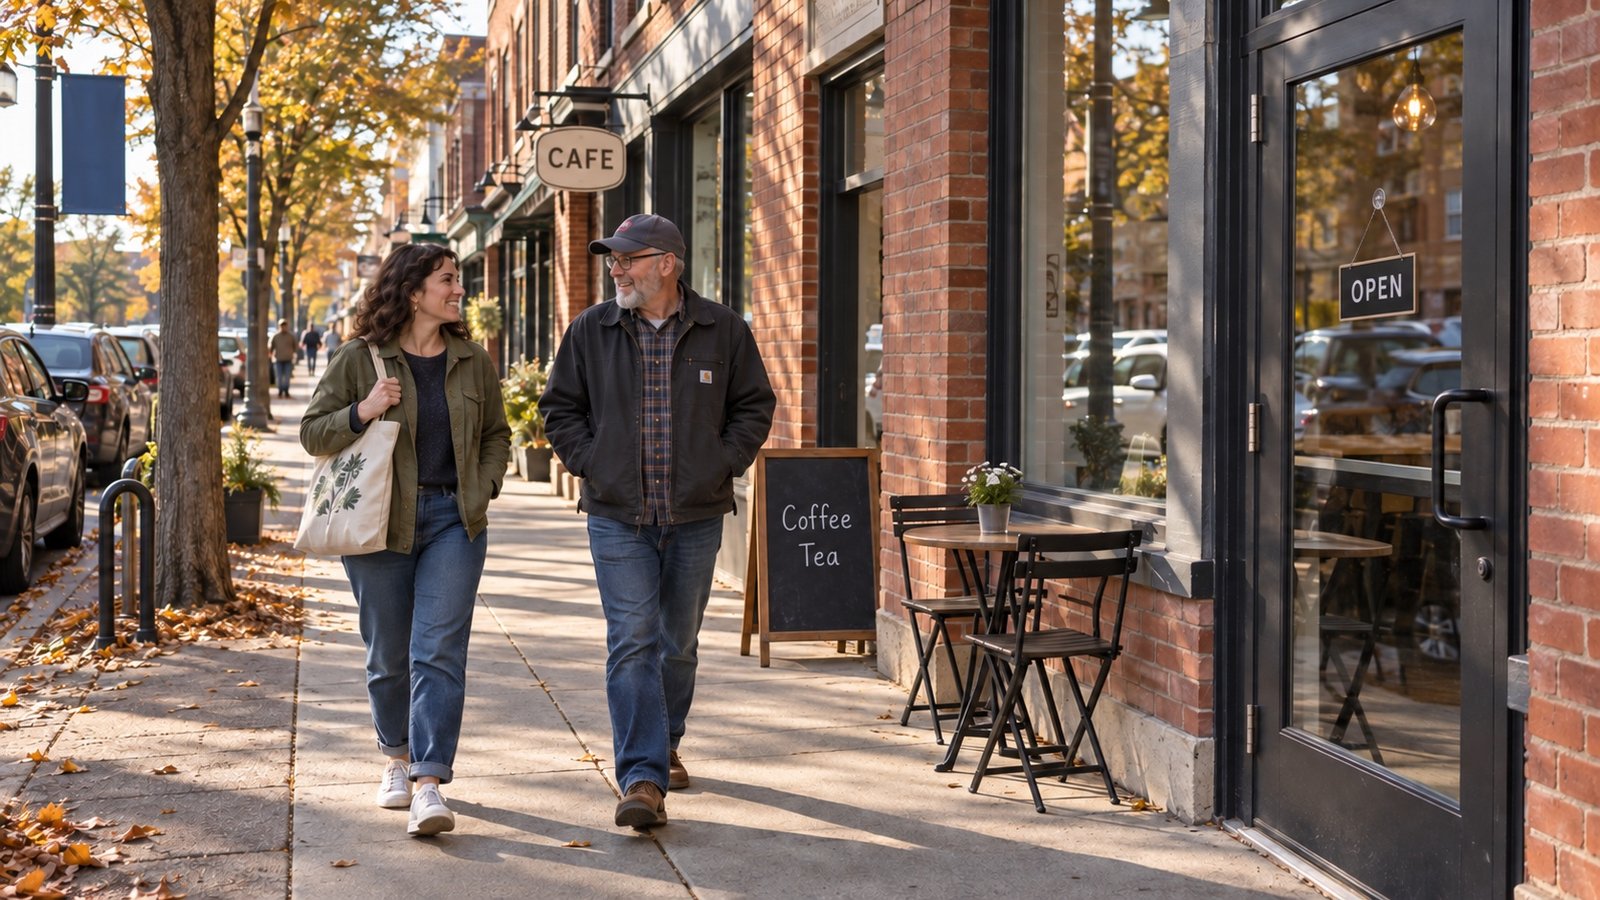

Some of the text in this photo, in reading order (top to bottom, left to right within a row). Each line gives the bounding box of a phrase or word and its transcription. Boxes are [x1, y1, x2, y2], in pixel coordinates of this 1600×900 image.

[548, 147, 614, 170] CAFE
[1351, 273, 1402, 303] OPEN
[782, 503, 852, 531] Coffee
[798, 542, 840, 567] Tea
